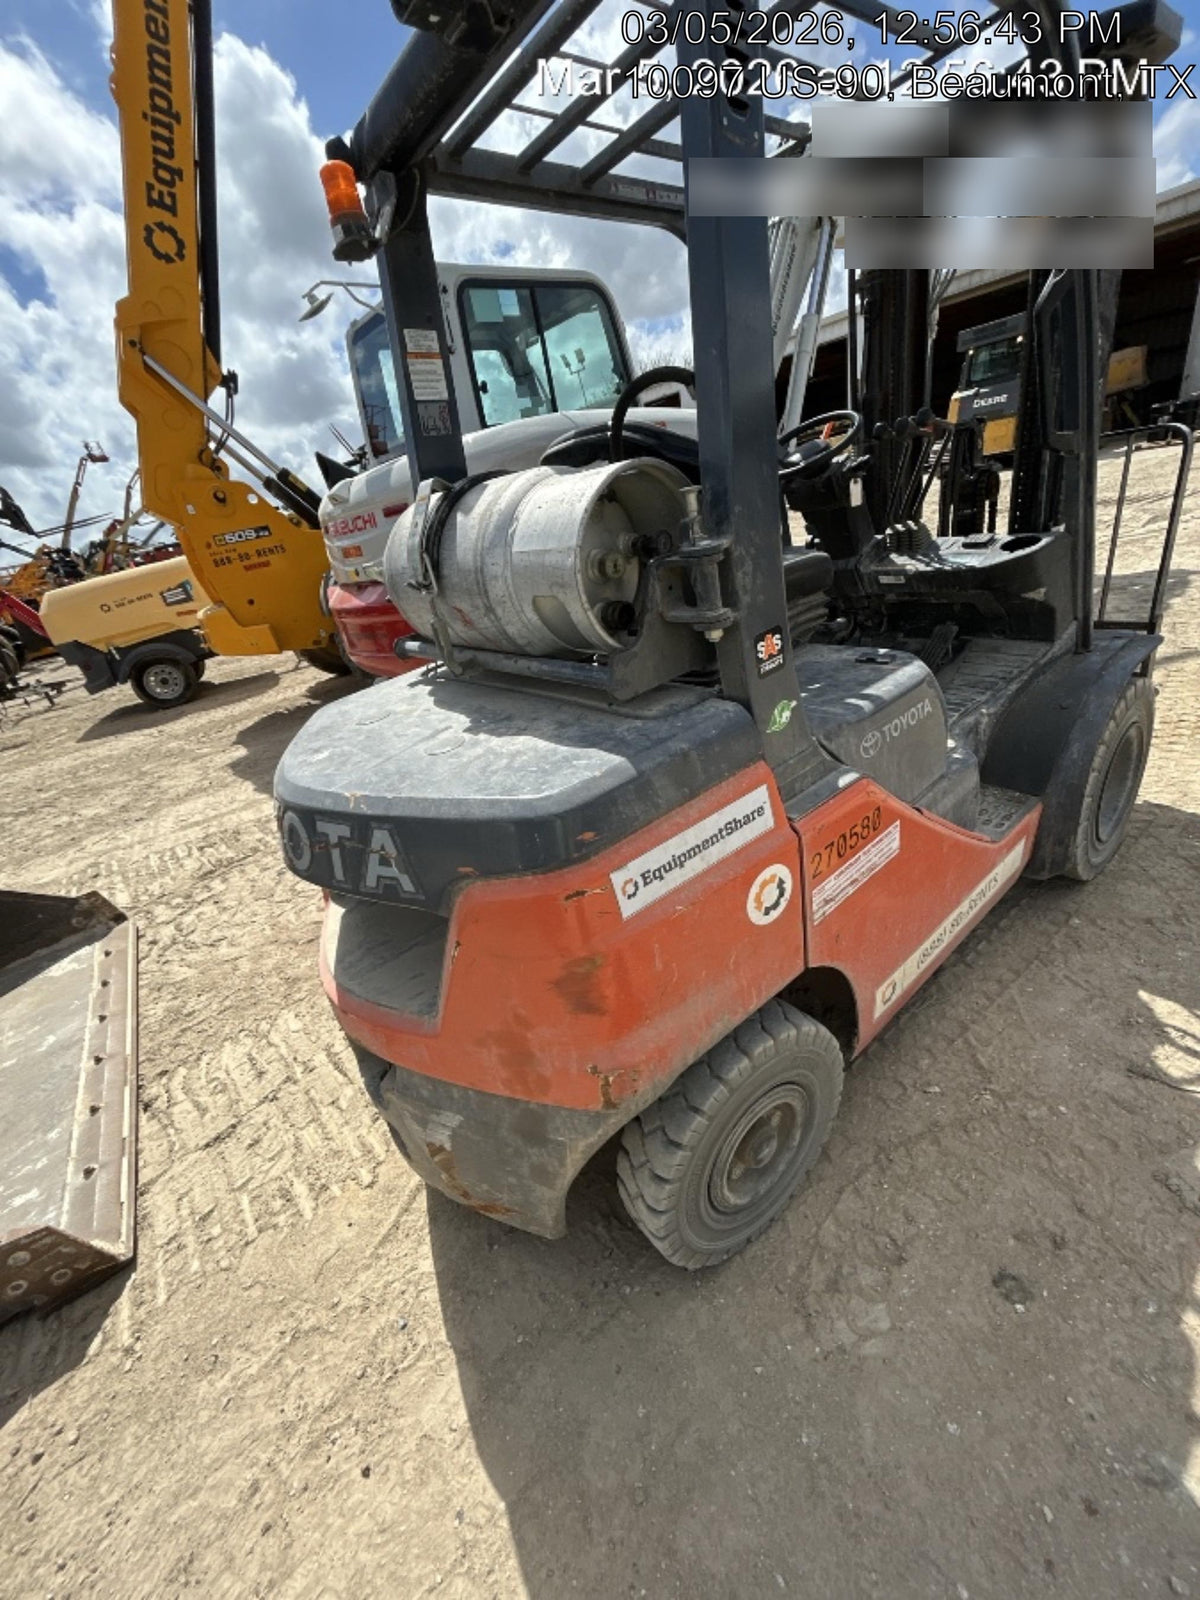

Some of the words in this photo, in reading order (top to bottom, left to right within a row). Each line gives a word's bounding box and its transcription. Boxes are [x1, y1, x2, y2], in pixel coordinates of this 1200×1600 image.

[756, 632, 782, 661] SAS
[882, 698, 932, 742] TOYOTA
[282, 809, 416, 893] OTA
[640, 803, 766, 888] EquipmentShare
[810, 805, 882, 880] 270580
